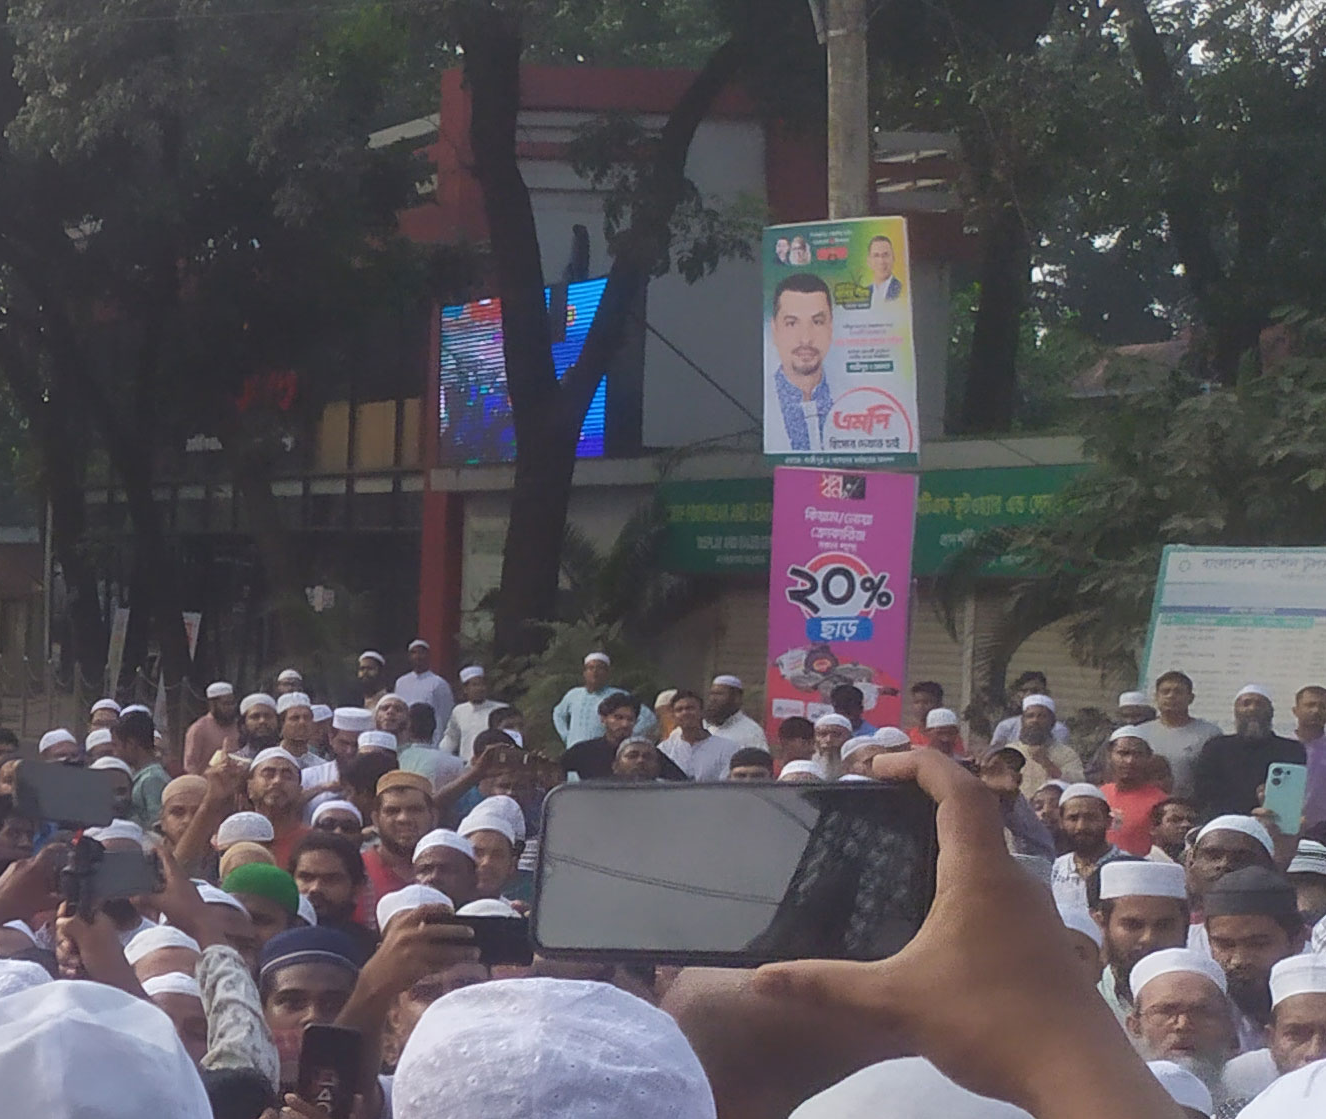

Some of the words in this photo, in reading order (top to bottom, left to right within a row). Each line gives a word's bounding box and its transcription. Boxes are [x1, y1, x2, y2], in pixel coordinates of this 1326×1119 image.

[833, 404, 897, 435] এমপি
[787, 566, 893, 616] ২০%
[820, 618, 860, 641] ছাড়
